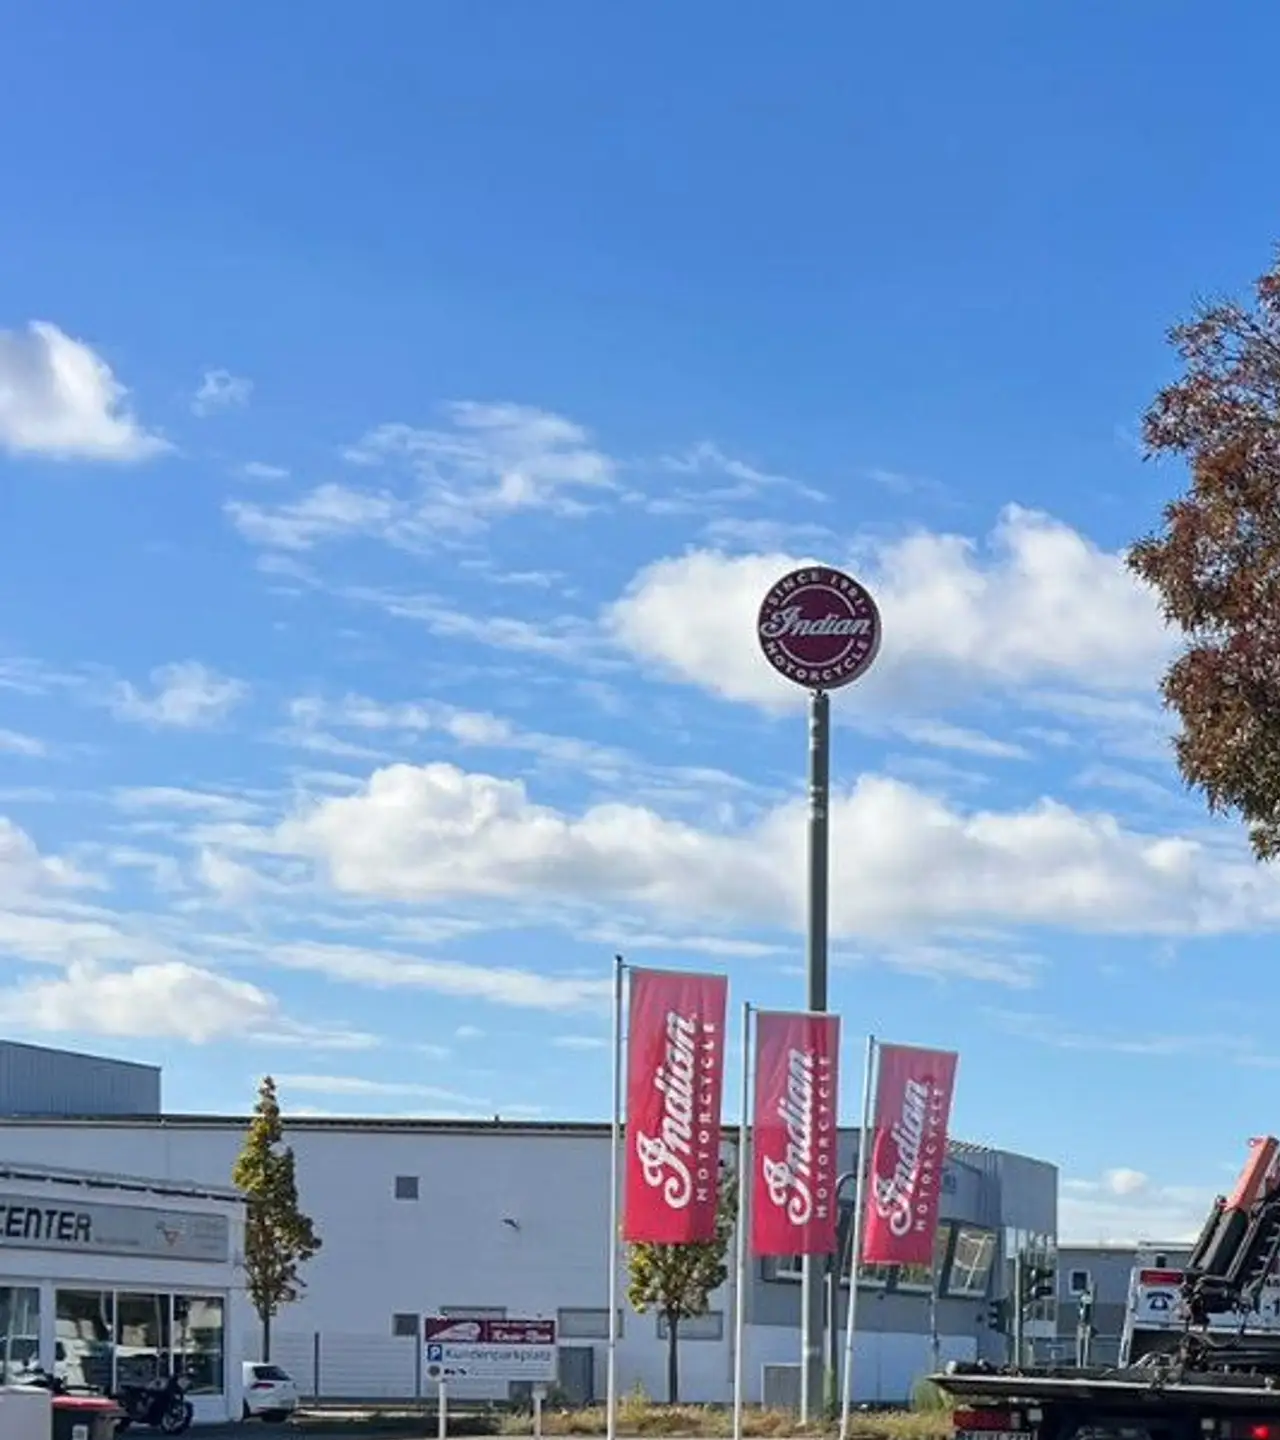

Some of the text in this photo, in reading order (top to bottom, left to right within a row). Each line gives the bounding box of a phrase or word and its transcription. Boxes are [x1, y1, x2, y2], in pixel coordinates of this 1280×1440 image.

[760, 606, 871, 637] Indian
[767, 640, 869, 681] MOTORCYCLE
[636, 1011, 695, 1209] Indian
[696, 1022, 715, 1202] MOTORCYCLE
[763, 1048, 813, 1226] Indian
[816, 1056, 831, 1218] MOTORCYCLE
[873, 1079, 928, 1236] Indian
[915, 1088, 944, 1231] MOTORCYCLE
